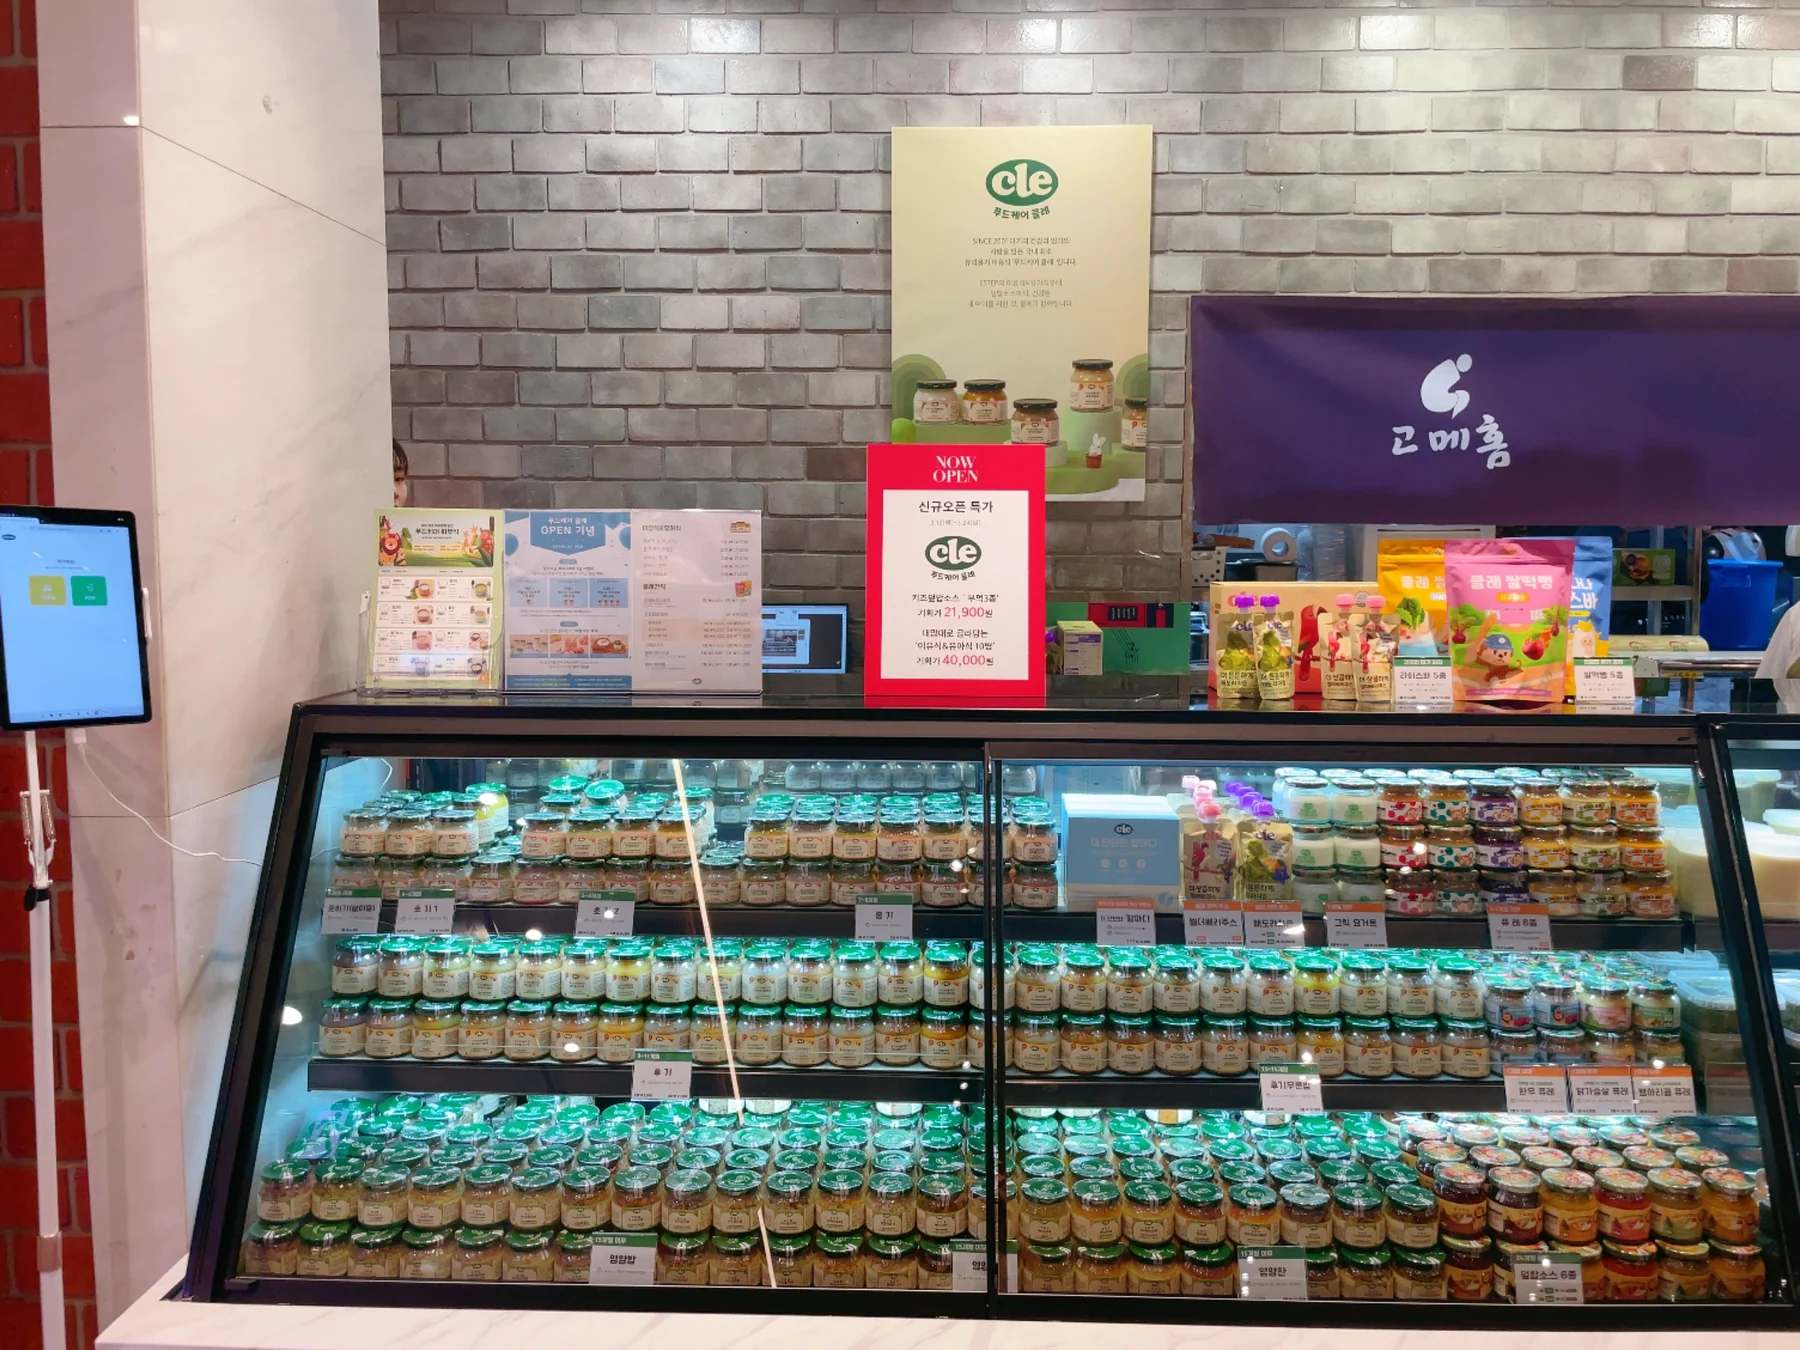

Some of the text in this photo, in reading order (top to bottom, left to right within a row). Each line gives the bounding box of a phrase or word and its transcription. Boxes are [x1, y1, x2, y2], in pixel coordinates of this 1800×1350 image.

[991, 163, 1053, 198] cle
[993, 205, 1051, 220] 푸드케어 클레
[936, 455, 976, 469] NOW
[932, 469, 979, 483] OPEN
[919, 500, 994, 514] 신규오픈 특가
[540, 525, 595, 536] OPEN 기념
[929, 538, 978, 565] cle
[1401, 574, 1430, 590] 클레
[1470, 574, 1553, 590] 클레 쌀떡뻥
[918, 606, 993, 620] 기획가 21,900원
[916, 654, 994, 667] 기획가 40,000원
[1400, 672, 1431, 680] 라이스바
[1334, 918, 1378, 927] 그릭 요거트
[1519, 1087, 1555, 1096] 한우 퓨레
[1576, 1087, 1629, 1096] 닭가슴살 퓨레
[1674, 1088, 1691, 1096] 퓨레
[1560, 1270, 1577, 1280] 6종
